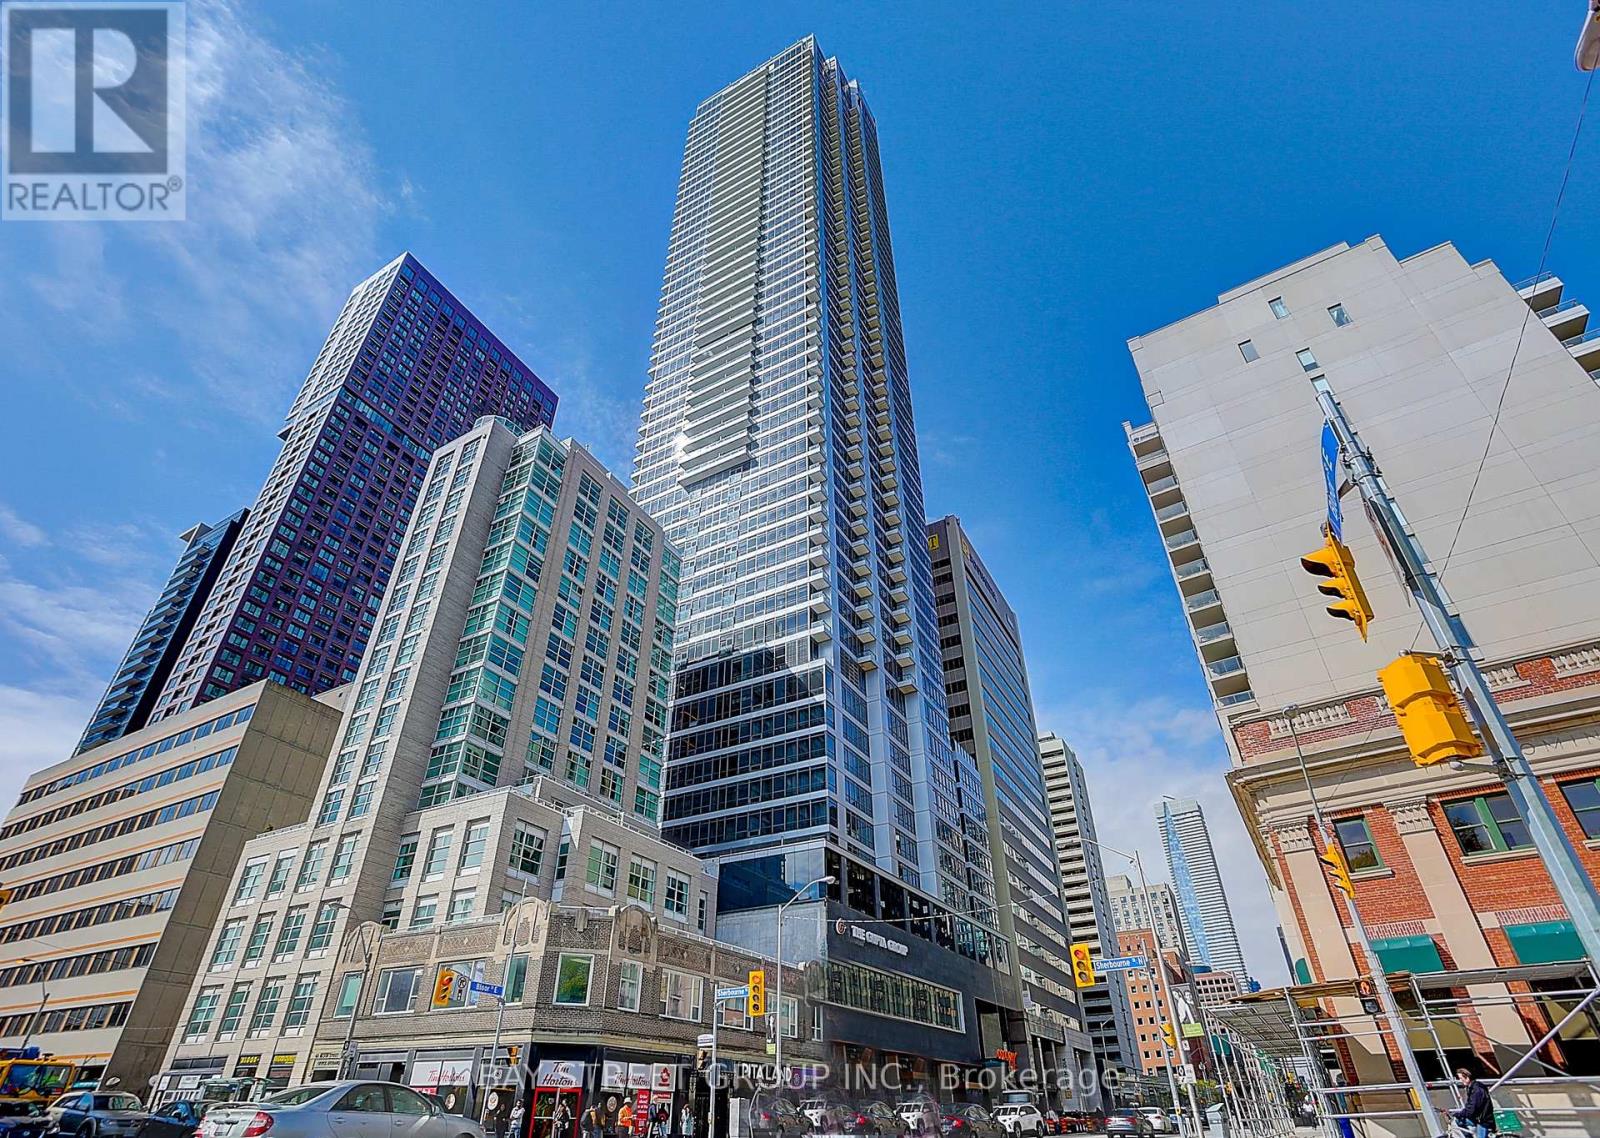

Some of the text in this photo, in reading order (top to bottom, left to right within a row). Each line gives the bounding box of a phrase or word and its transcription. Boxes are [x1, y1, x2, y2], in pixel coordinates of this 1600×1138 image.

[851, 925, 866, 940] THE
[887, 939, 909, 956] GROUP
[1095, 959, 1131, 970] Sherbourne
[1138, 955, 1145, 966] N
[475, 981, 491, 993] Bloor
[494, 986, 499, 994] E
[717, 988, 745, 998] Sherbourne
[553, 1061, 570, 1074] Tim
